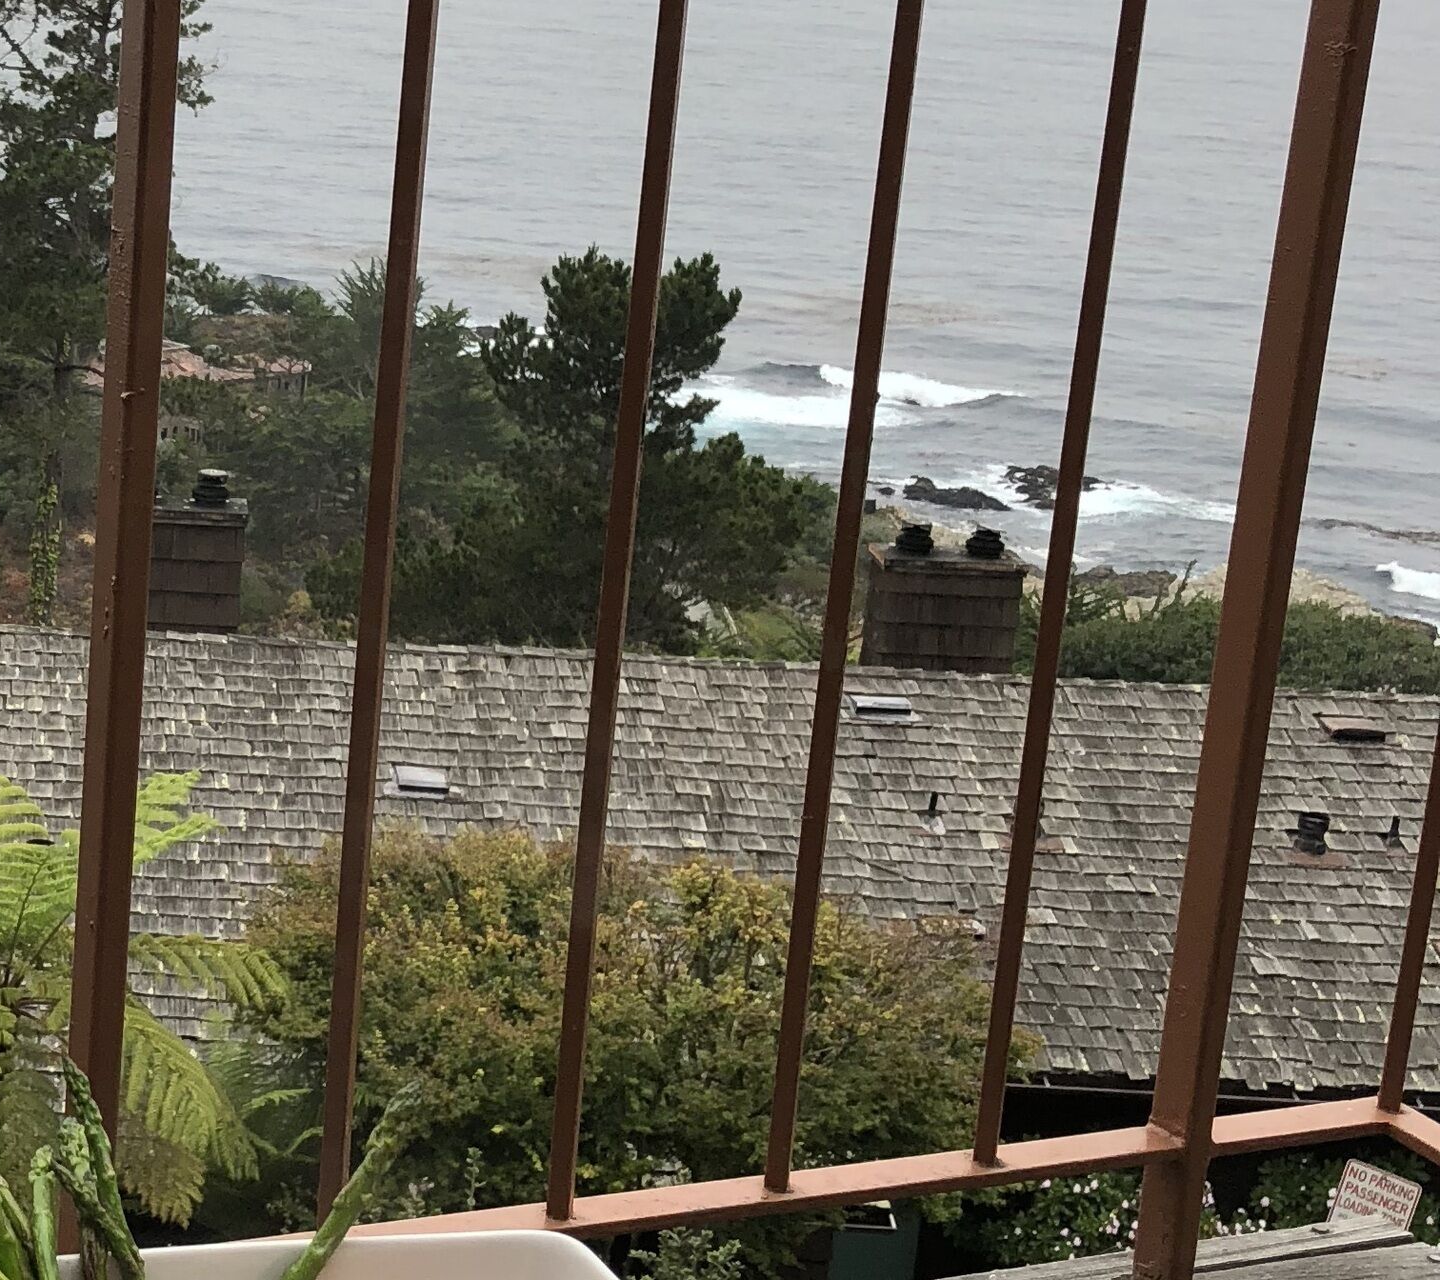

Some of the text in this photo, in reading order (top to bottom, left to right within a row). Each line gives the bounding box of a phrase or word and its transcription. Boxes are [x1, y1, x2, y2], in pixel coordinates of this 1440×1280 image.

[1344, 1181, 1410, 1217] PASSENGER
[1348, 1166, 1415, 1202] NO PARKING
